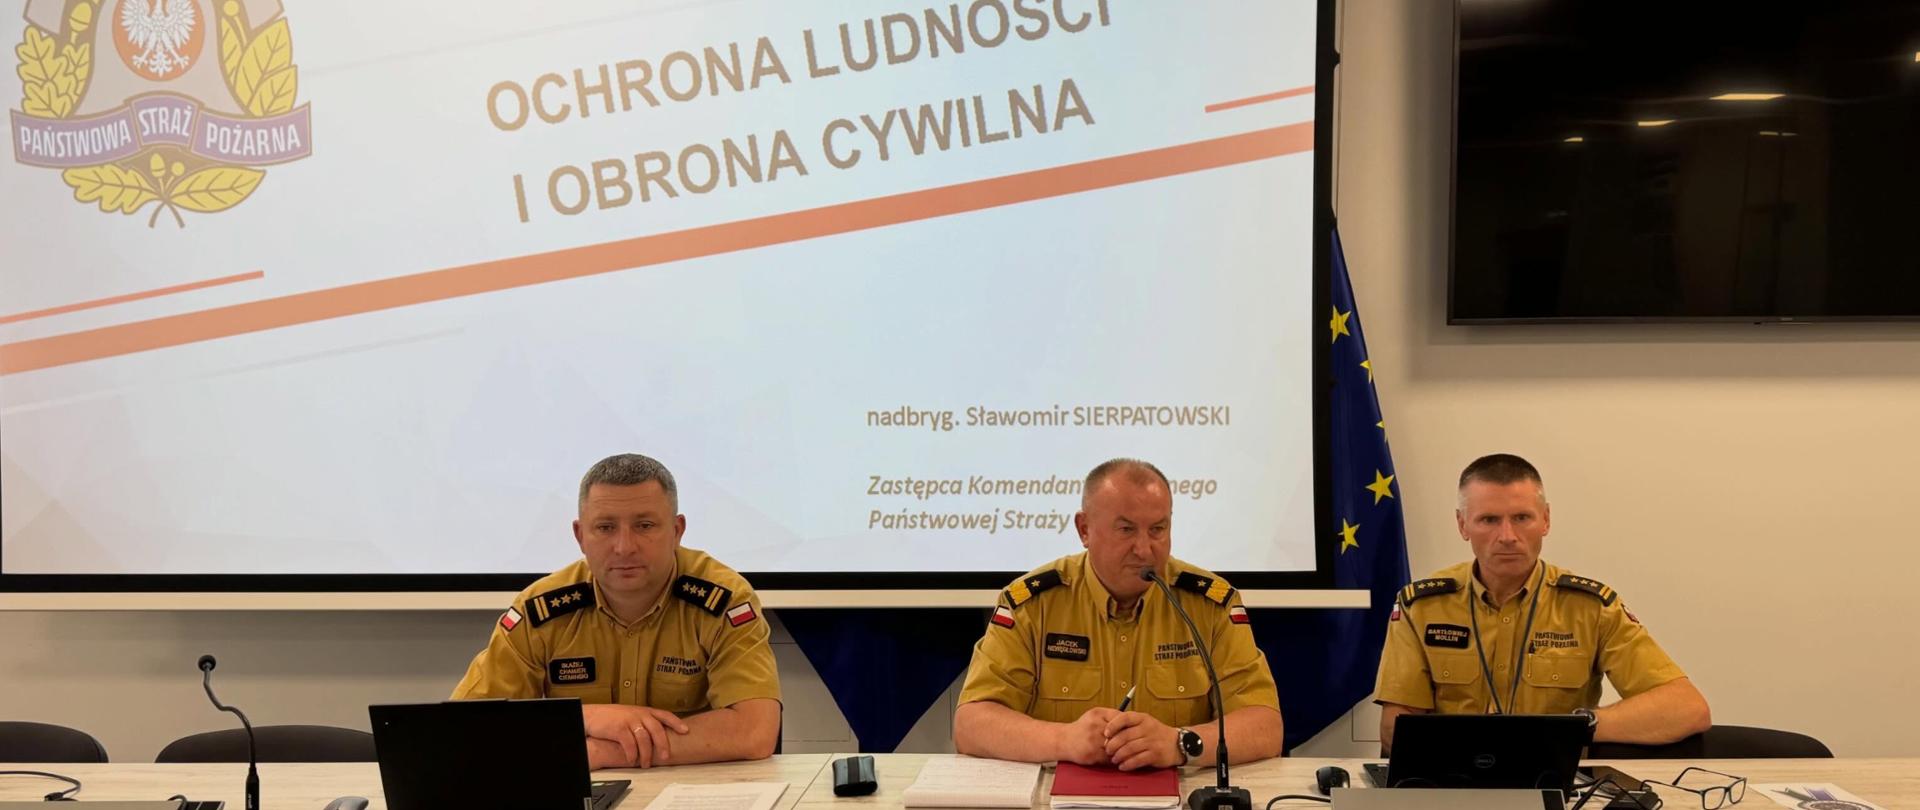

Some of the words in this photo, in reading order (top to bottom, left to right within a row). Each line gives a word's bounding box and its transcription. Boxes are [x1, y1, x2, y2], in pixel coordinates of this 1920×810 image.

[486, 37, 791, 131] OCHRONA
[20, 119, 131, 159] PAŃSTWOWA
[138, 105, 192, 137] STRAŻ
[206, 122, 300, 156] POŻARNA
[513, 174, 530, 223] I
[547, 130, 808, 216] OBRONA
[821, 78, 1095, 170] CYWILNA
[867, 406, 960, 431] nadbryg.
[966, 404, 1069, 426] Sławomir
[1073, 406, 1230, 426] SIERPATOWSKI
[867, 475, 962, 499] Zastępca
[968, 474, 1084, 495] Komendan
[868, 508, 1000, 533] Państwowej
[1003, 508, 1070, 533] Straży
[1056, 639, 1079, 648] JACEK
